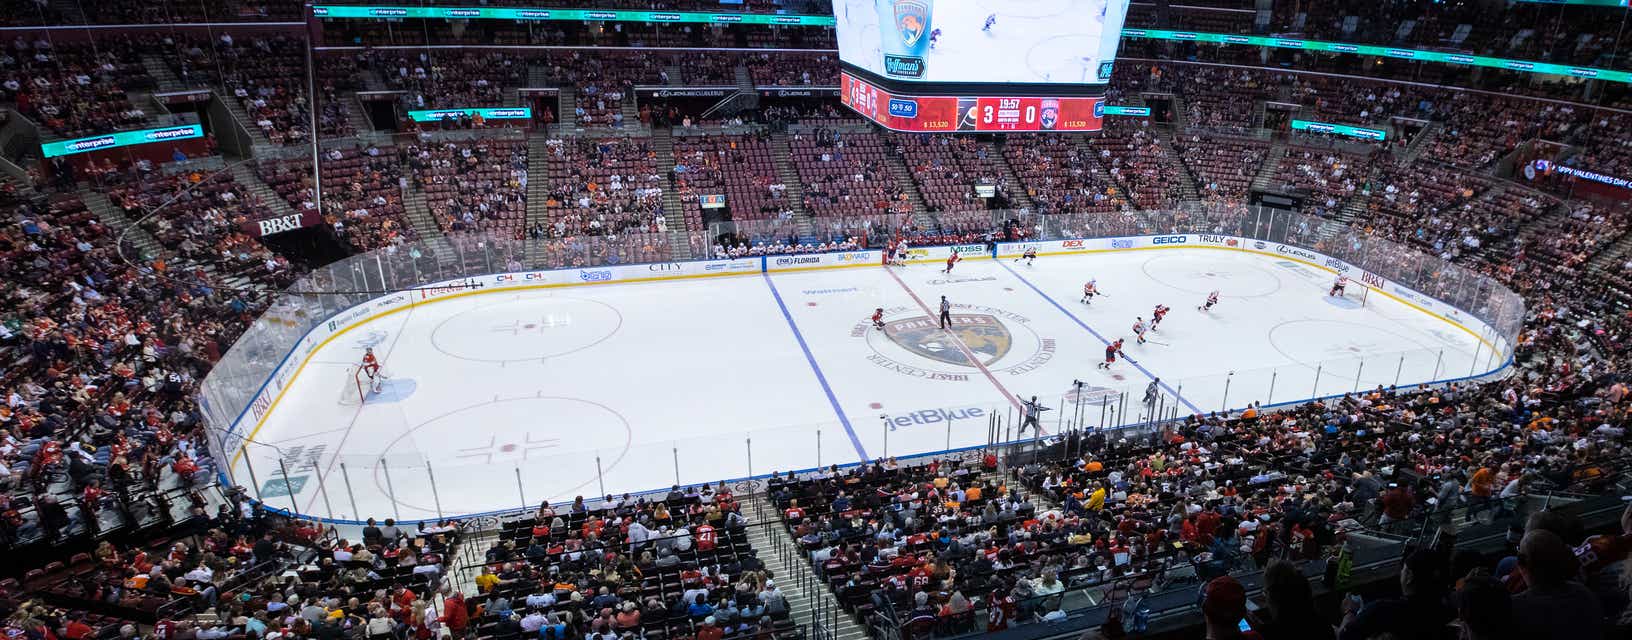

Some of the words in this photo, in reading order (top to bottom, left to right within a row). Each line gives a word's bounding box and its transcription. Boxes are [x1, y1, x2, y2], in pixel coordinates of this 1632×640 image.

[1000, 99, 1020, 109] 19:57
[487, 108, 525, 117] enterprise
[984, 106, 994, 123] 3
[1026, 106, 1035, 123] 0
[145, 128, 195, 141] enterprise
[65, 138, 115, 151] enterprise
[258, 213, 304, 237] BB&T
[1152, 235, 1187, 244] GEICO
[1198, 234, 1226, 243] TRULY
[950, 245, 982, 254] MOSS
[1287, 249, 1316, 261] LEXUS
[794, 256, 820, 265] FLORIDA
[1361, 271, 1385, 289] BB&T
[885, 407, 986, 432] jetBlue
[700, 531, 711, 541] 21
